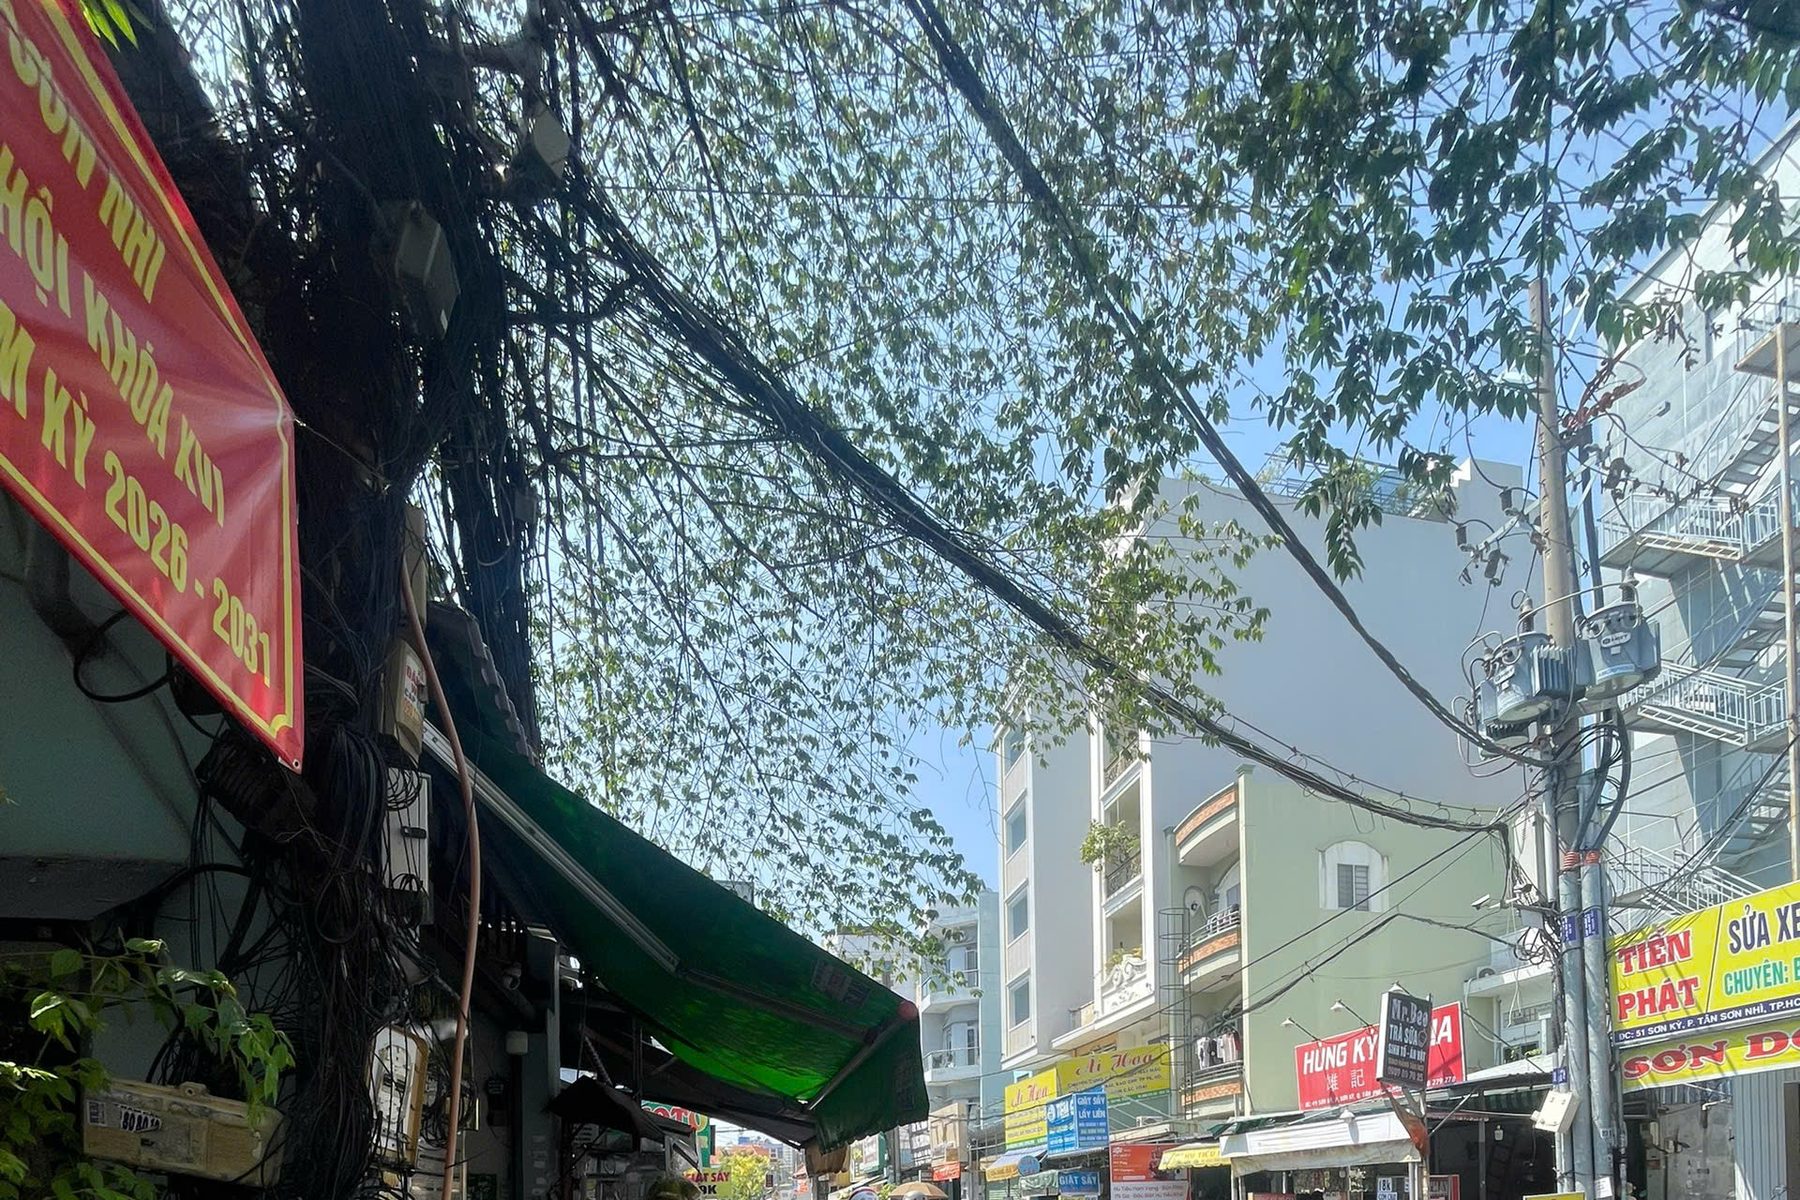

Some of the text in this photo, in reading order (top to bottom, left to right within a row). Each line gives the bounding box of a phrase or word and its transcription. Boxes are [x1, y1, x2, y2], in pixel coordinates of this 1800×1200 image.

[84, 268, 174, 460] KHÓA
[174, 413, 224, 528] XVI
[104, 449, 188, 594] 2026
[212, 576, 270, 688] 2031
[1728, 904, 1771, 954] SỬA
[1617, 976, 1699, 1021] PHÁT
[1724, 959, 1789, 996] CHUYÊN:
[1636, 1029, 1646, 1038] 51
[1647, 1025, 1668, 1036] SƠN
[1697, 1014, 1718, 1025] TÂN
[1720, 1009, 1743, 1020] SƠN
[1623, 1030, 1800, 1080] SƠN D
